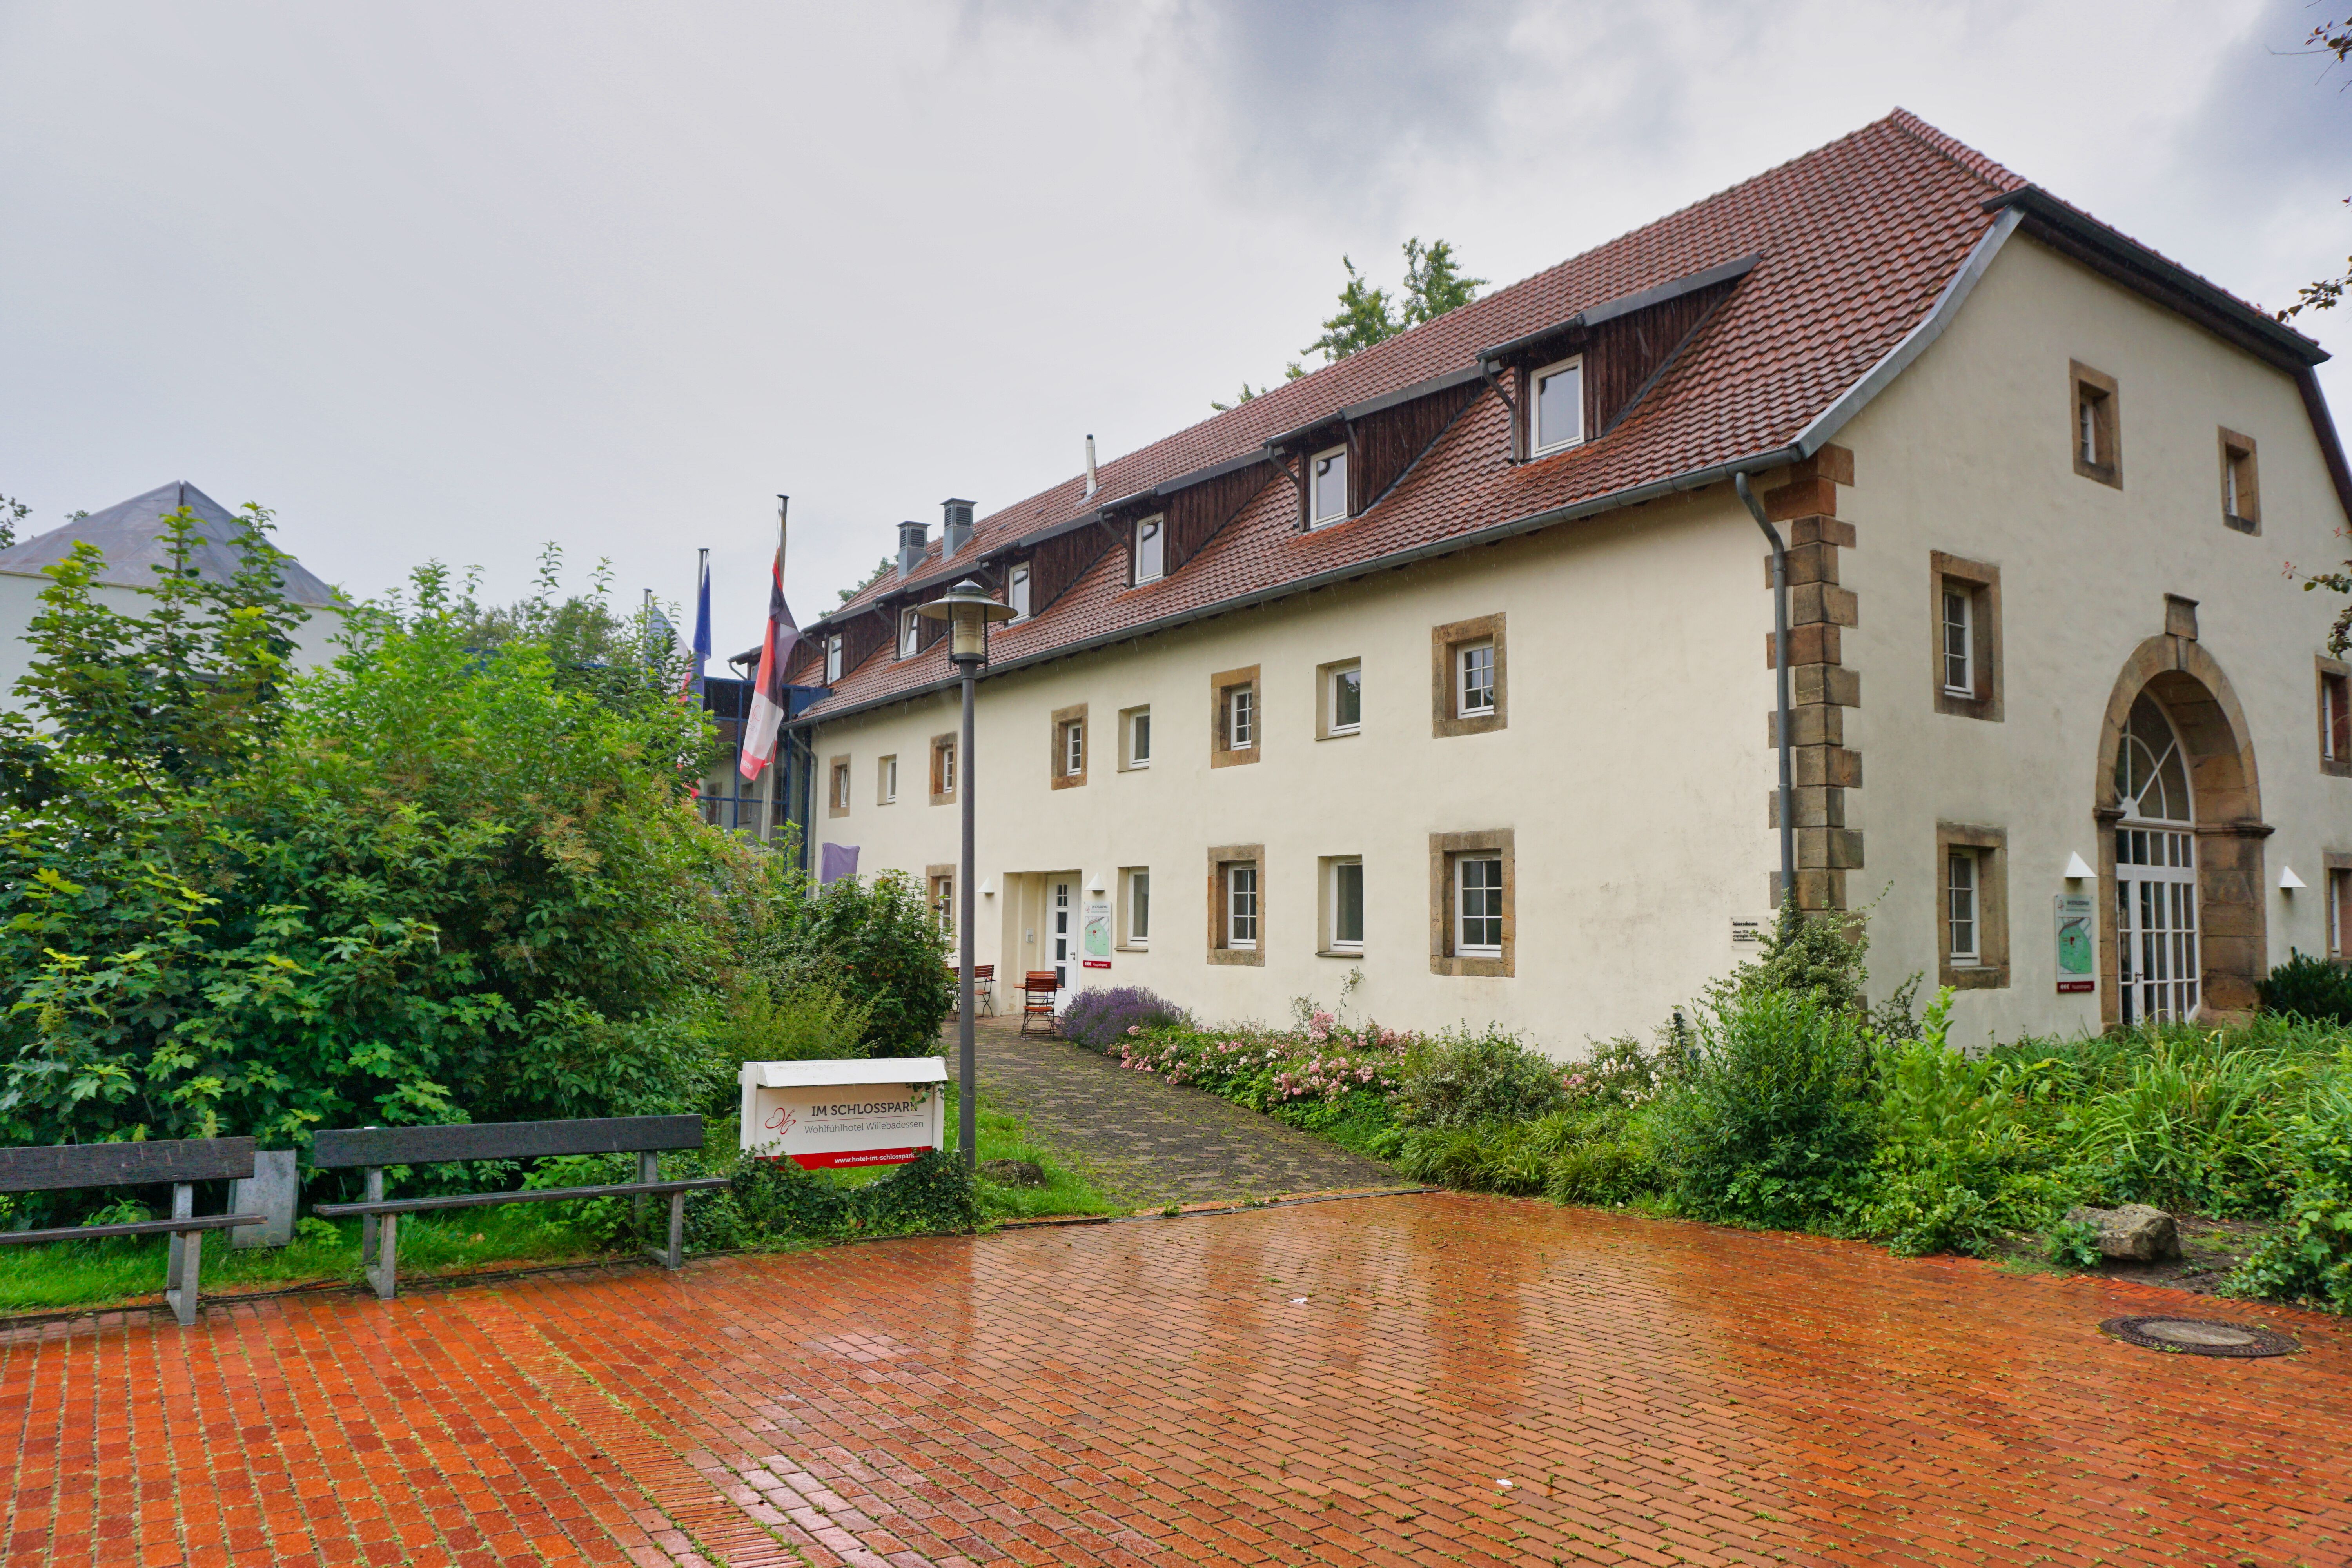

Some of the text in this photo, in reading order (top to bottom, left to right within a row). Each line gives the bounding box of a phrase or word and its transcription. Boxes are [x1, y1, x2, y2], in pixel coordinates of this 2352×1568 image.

[811, 1102, 917, 1116] IM SCHLOSSPARK
[804, 1121, 924, 1133] Wohlfühlhotel Willebadessen
[834, 1152, 920, 1163] www.hotel-im-schlosspark.
